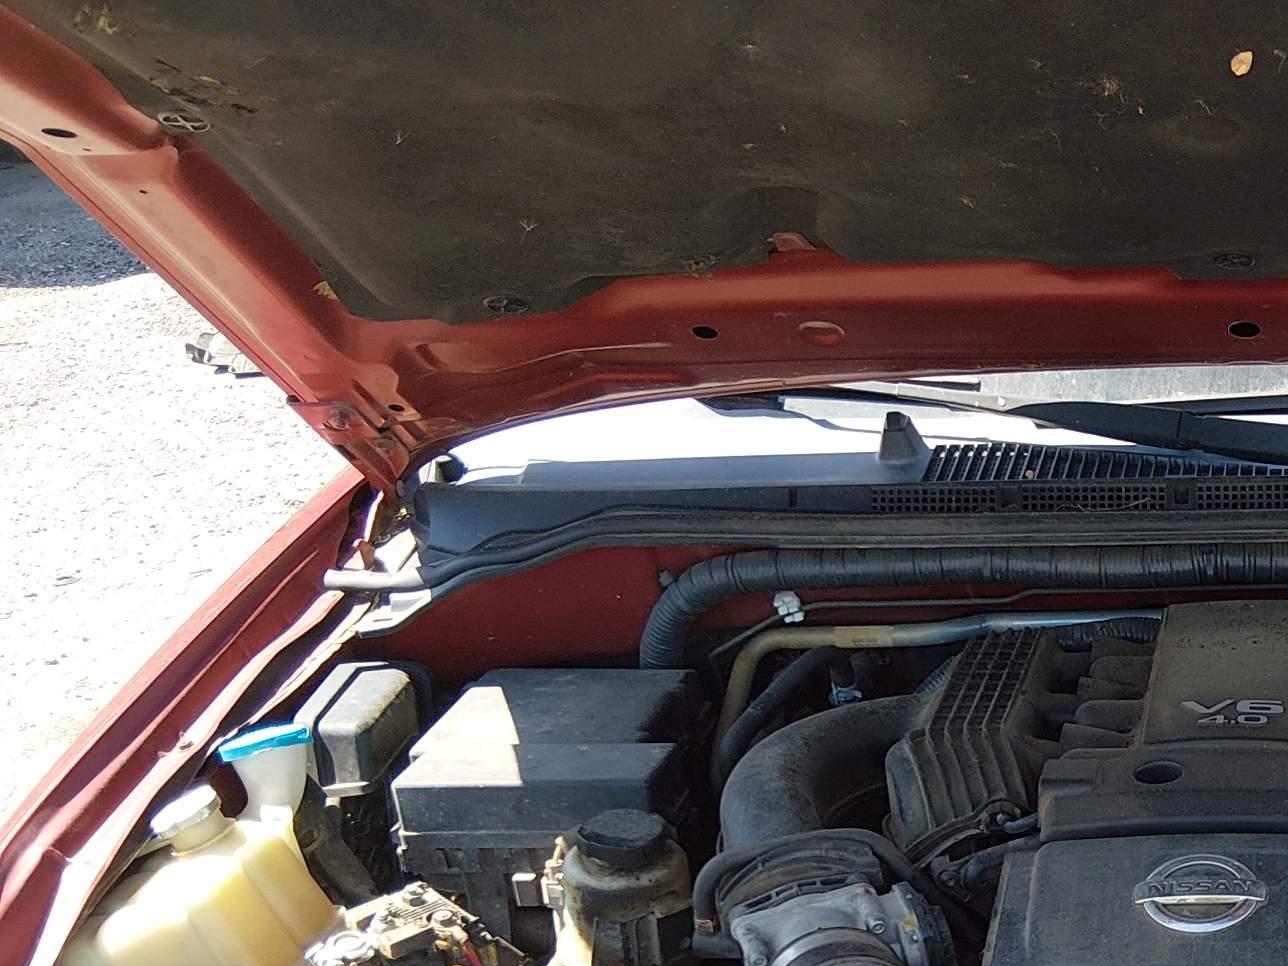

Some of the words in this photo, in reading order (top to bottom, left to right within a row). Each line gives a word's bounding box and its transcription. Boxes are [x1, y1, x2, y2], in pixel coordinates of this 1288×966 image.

[1180, 699, 1284, 714] V6
[1197, 714, 1268, 724] 4.0
[1149, 879, 1252, 894] NISSAN
